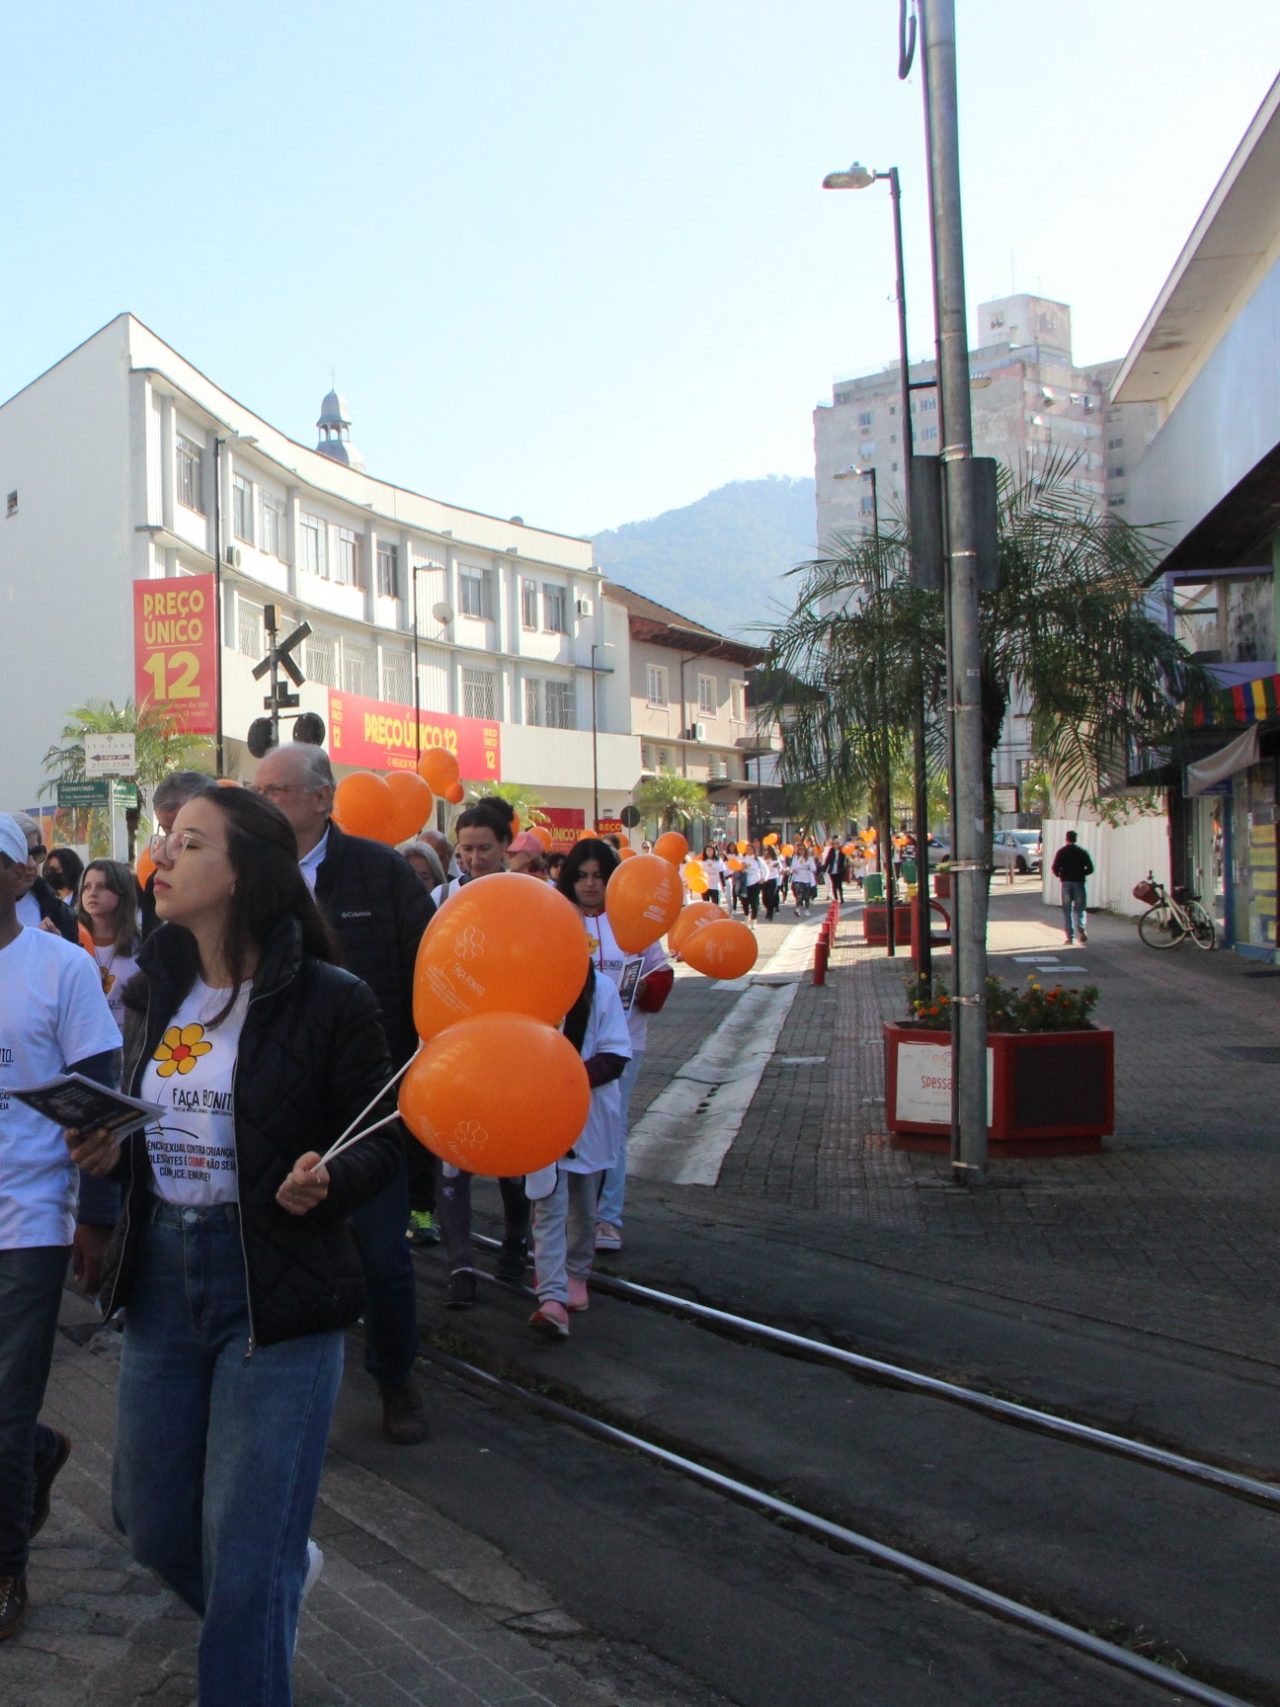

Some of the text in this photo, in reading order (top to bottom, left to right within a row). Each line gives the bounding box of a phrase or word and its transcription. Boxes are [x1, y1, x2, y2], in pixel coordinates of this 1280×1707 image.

[143, 590, 205, 617] PREÇO
[144, 615, 203, 644] ÚNICO
[143, 651, 201, 700] 12
[363, 712, 458, 756] PREÇO ÚNICO 12
[172, 1088, 200, 1108] FAÇA
